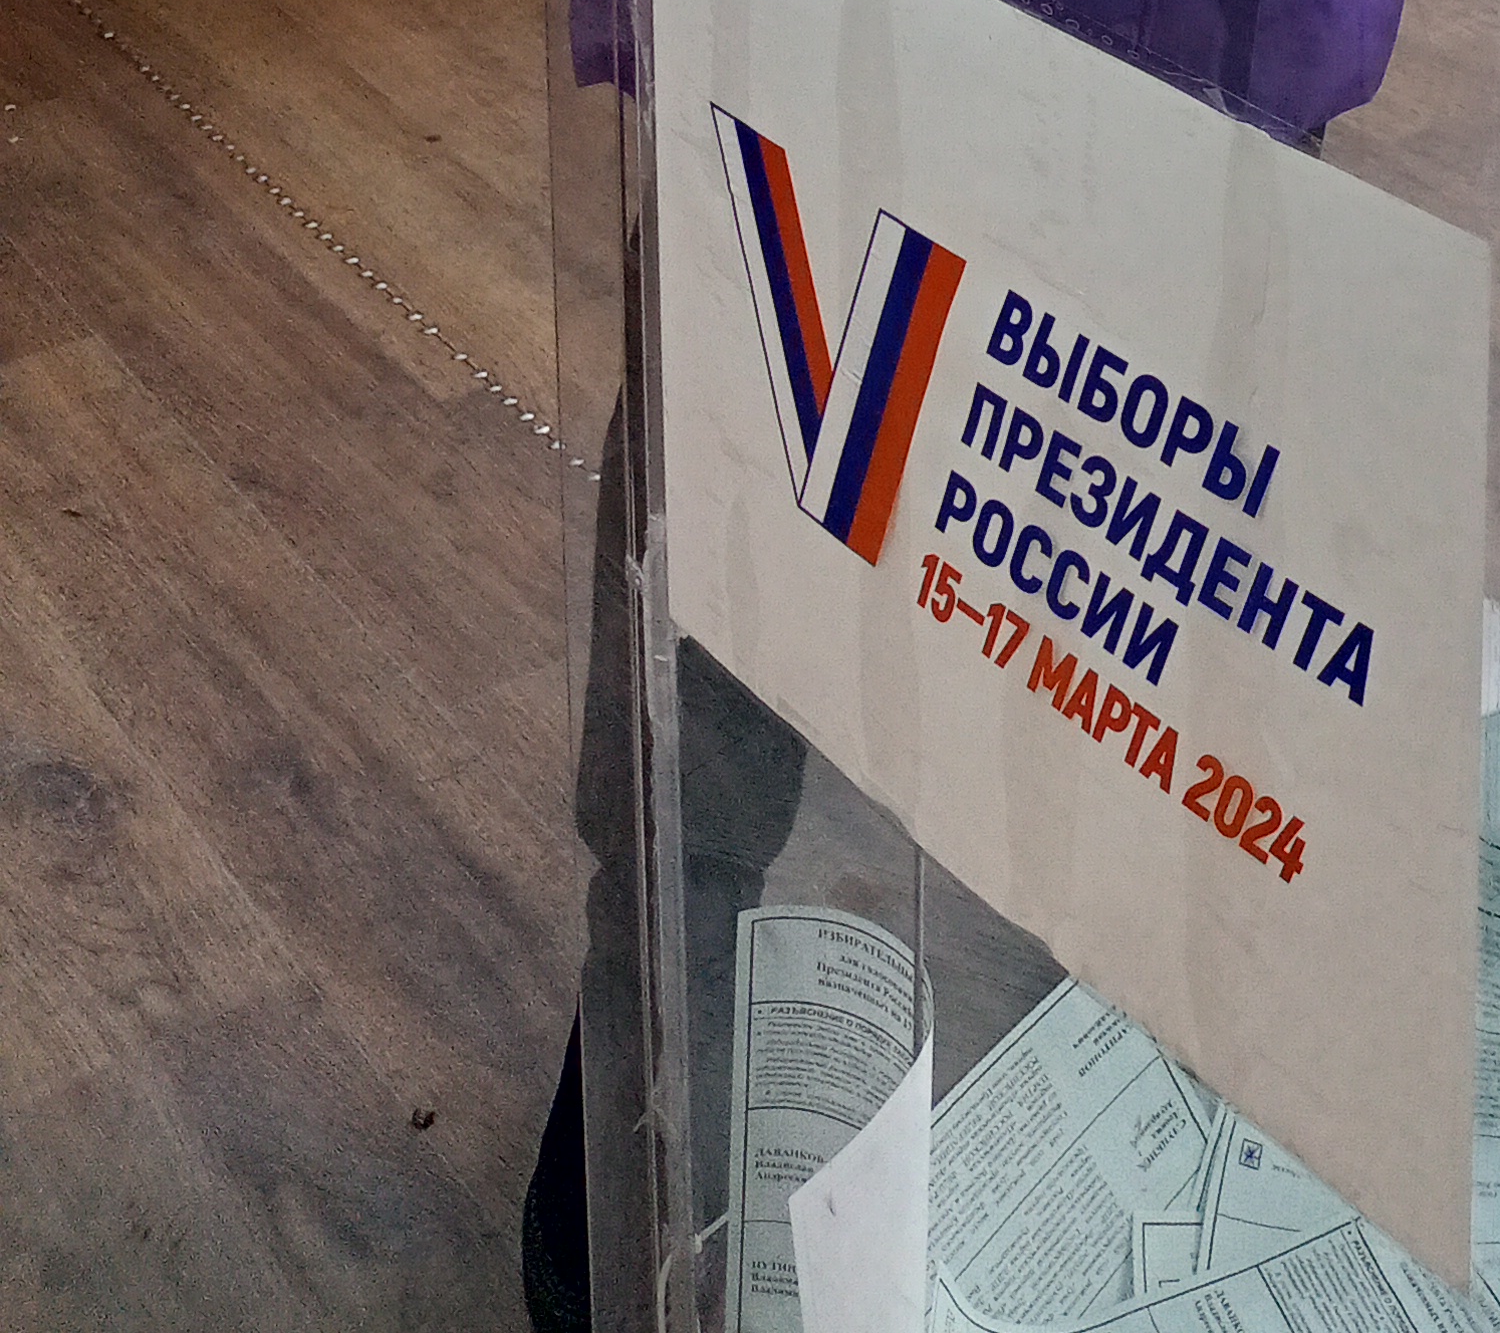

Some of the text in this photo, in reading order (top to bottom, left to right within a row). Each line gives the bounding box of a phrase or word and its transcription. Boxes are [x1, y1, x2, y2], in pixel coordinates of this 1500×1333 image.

[986, 290, 1280, 518] ВЫБОРЫ
[935, 470, 1179, 687] РОССИИ
[960, 383, 1375, 707] ПРЕЗИДЕНТА
[1027, 636, 1180, 795] МАРТА
[1182, 754, 1306, 884] 2024
